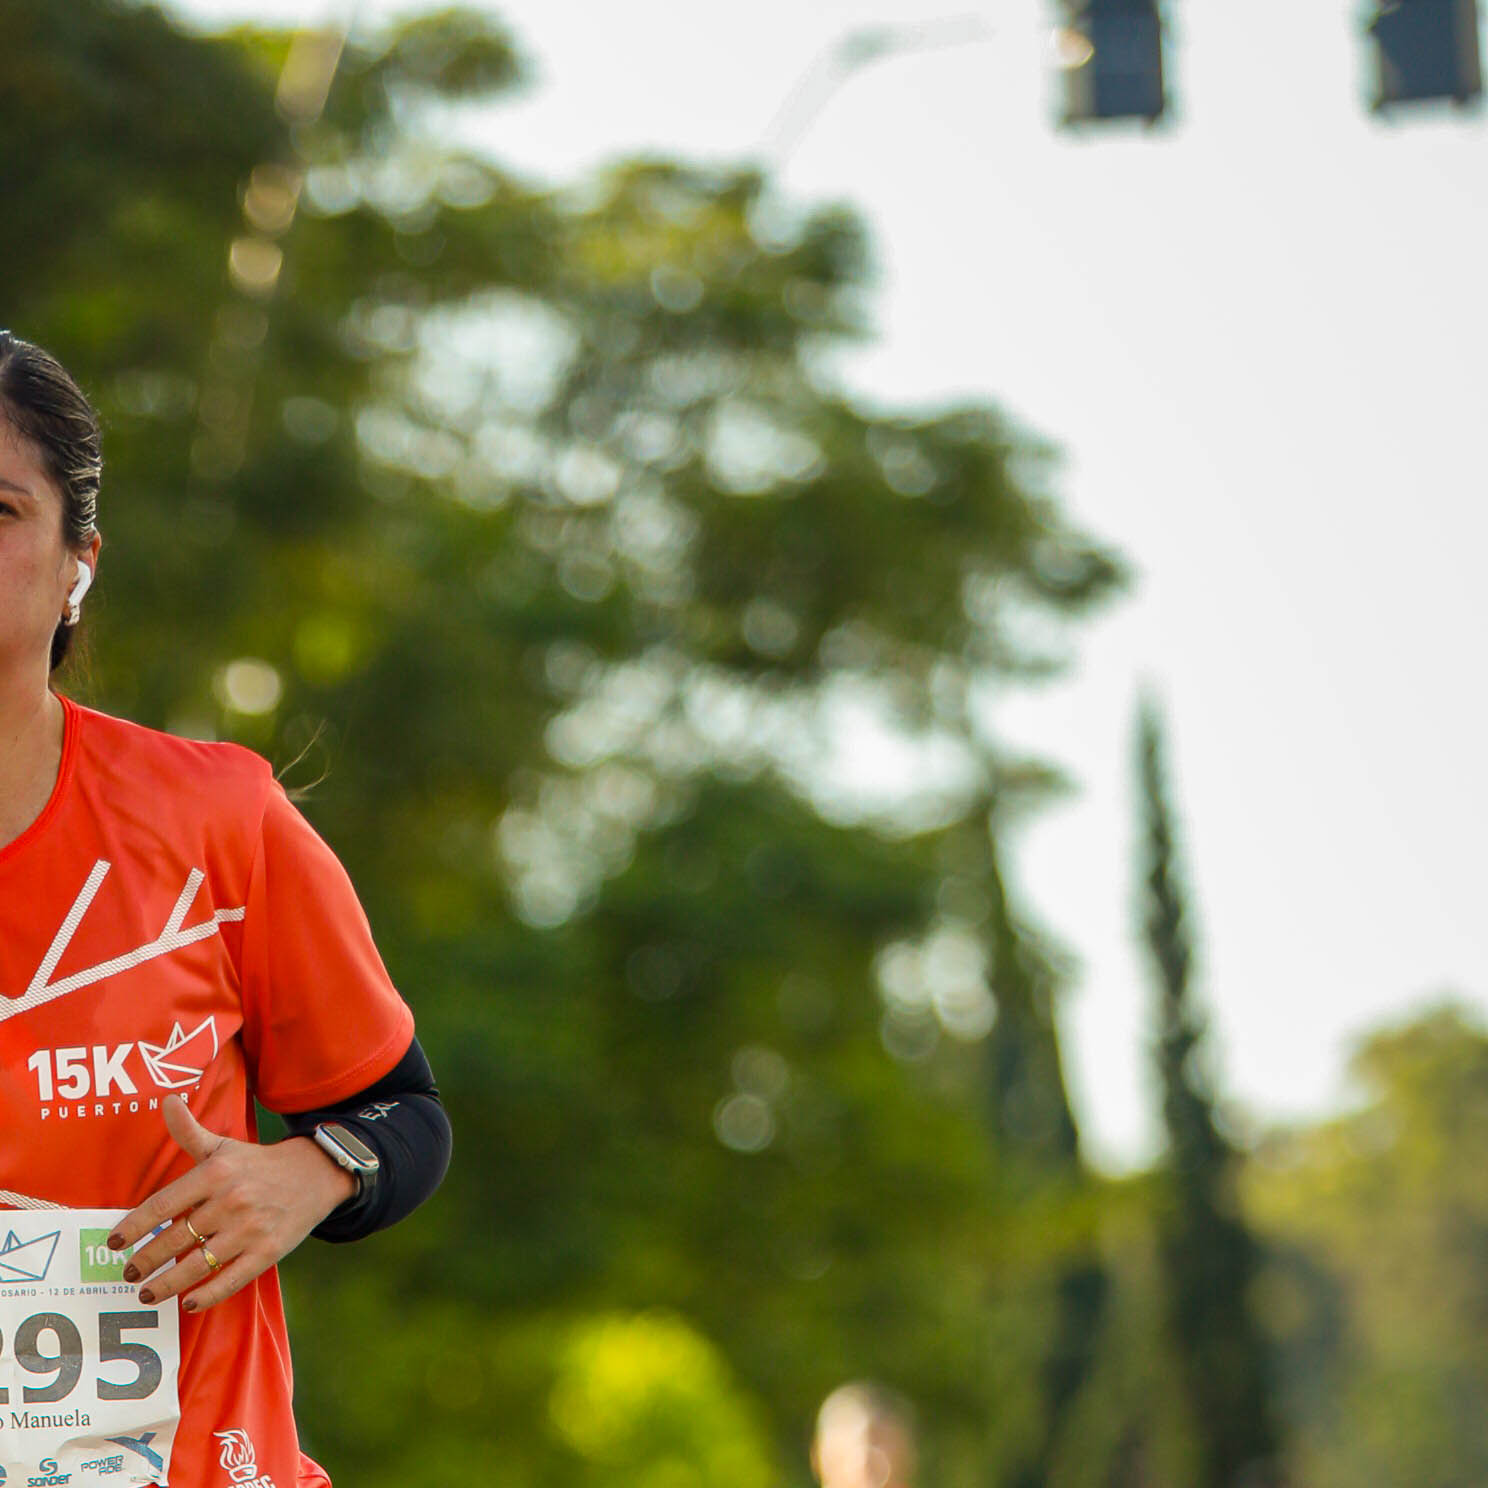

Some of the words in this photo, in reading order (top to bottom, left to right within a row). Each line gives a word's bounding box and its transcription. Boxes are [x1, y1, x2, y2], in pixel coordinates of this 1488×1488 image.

[28, 1043, 138, 1101] 15K
[85, 1245, 129, 1266] 10K
[49, 1288, 59, 1296] 12
[63, 1287, 75, 1296] DE
[79, 1286, 109, 1295] ABRIL
[10, 1409, 91, 1429] Manuela
